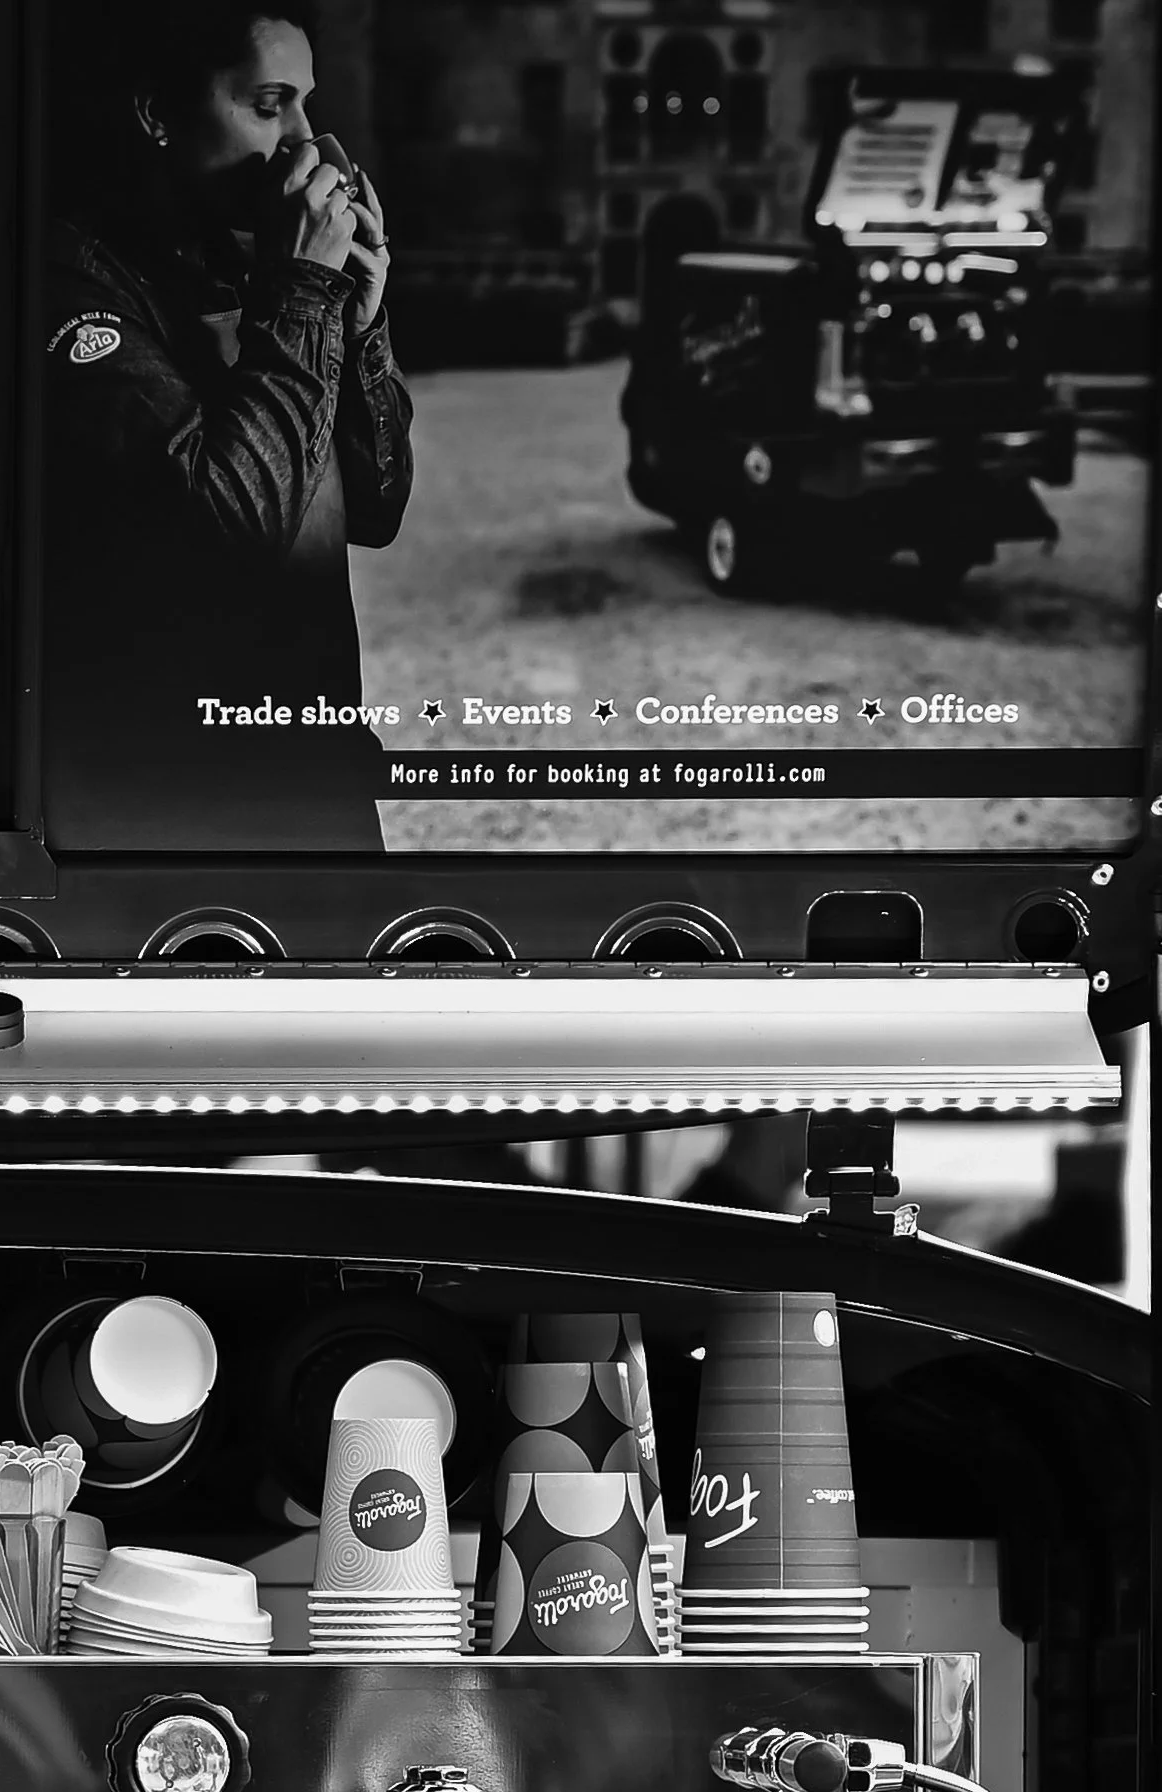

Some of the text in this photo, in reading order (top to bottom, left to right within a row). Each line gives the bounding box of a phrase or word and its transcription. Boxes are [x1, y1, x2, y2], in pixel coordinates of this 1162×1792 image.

[79, 333, 113, 358] Arla
[197, 694, 1019, 726] Trade shows Events Conferences Offices
[391, 762, 826, 788] More info for booking at fogarolli.com
[354, 1493, 422, 1529] Fogarolli
[534, 1575, 629, 1626] Fogarolli
